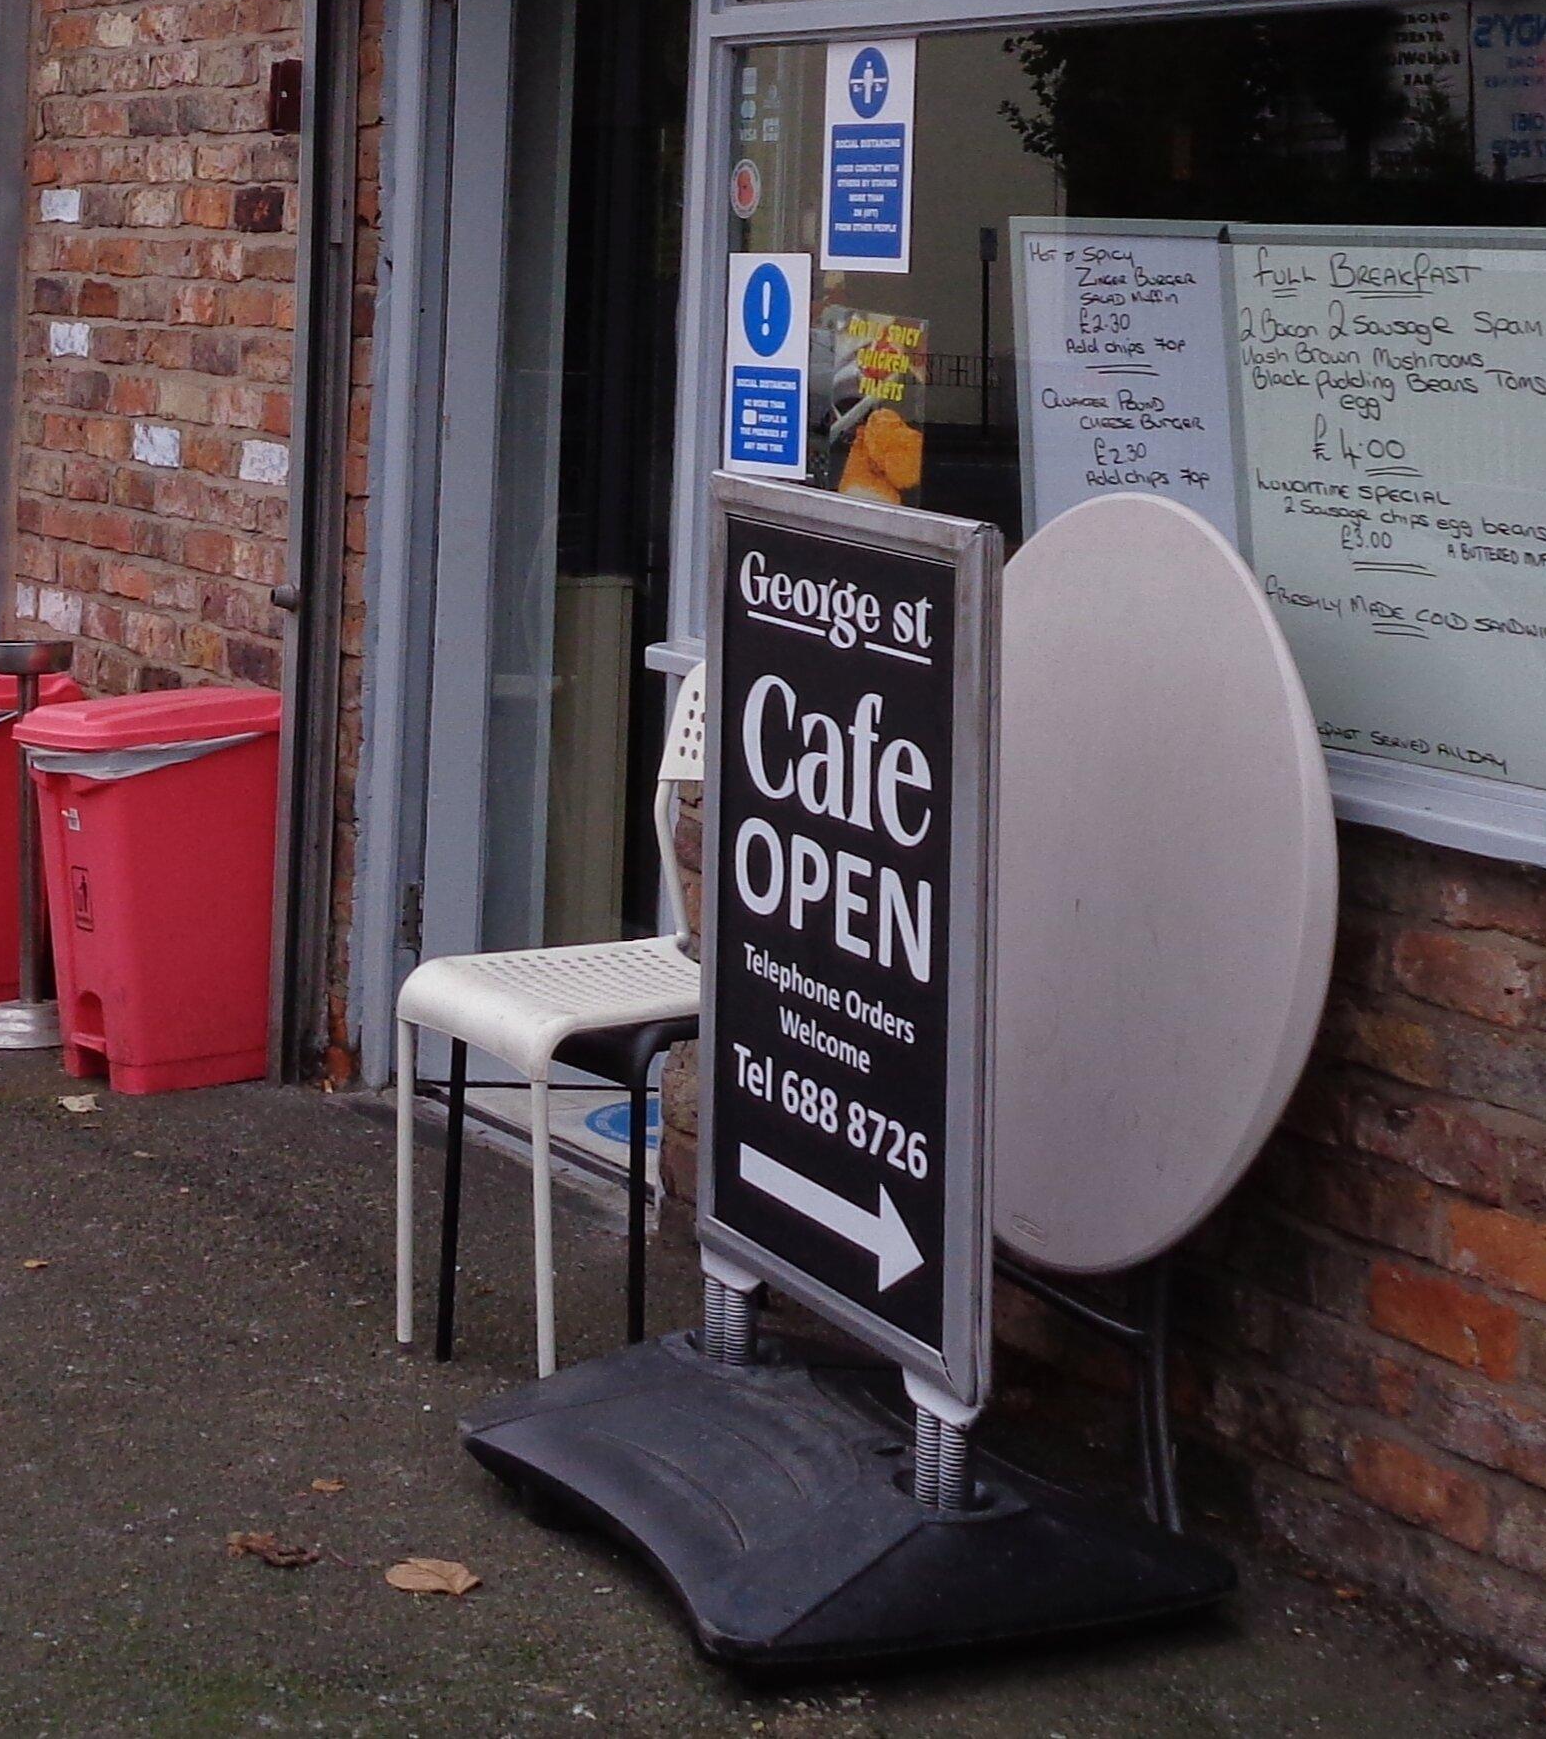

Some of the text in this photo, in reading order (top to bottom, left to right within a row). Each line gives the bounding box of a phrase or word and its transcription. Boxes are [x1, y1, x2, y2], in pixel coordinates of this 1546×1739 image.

[888, 324, 922, 347] SPICY
[1240, 307, 1255, 341] 2
[1260, 308, 1318, 343] Bacon
[1328, 300, 1348, 340] 2
[1353, 314, 1454, 346] Sausage
[857, 348, 910, 373] CHICKEN
[1105, 337, 1146, 358] chips
[1295, 342, 1360, 364] Brown
[859, 377, 904, 402] FILLETS
[1253, 365, 1310, 391] Black
[1406, 373, 1479, 393] Beans
[1340, 394, 1380, 420] egg
[1357, 484, 1451, 506] SPECIAL
[1284, 496, 1296, 514] 2
[1380, 508, 1429, 530] chips
[1436, 517, 1473, 538] egg
[739, 550, 933, 648] George st
[1350, 595, 1405, 621] MADE
[741, 674, 932, 847] Cafe
[734, 816, 931, 984] OPEN
[743, 941, 915, 1045] Telephone Orders
[778, 1005, 871, 1074] Welcome
[733, 1042, 928, 1179] Tel 688 8726
